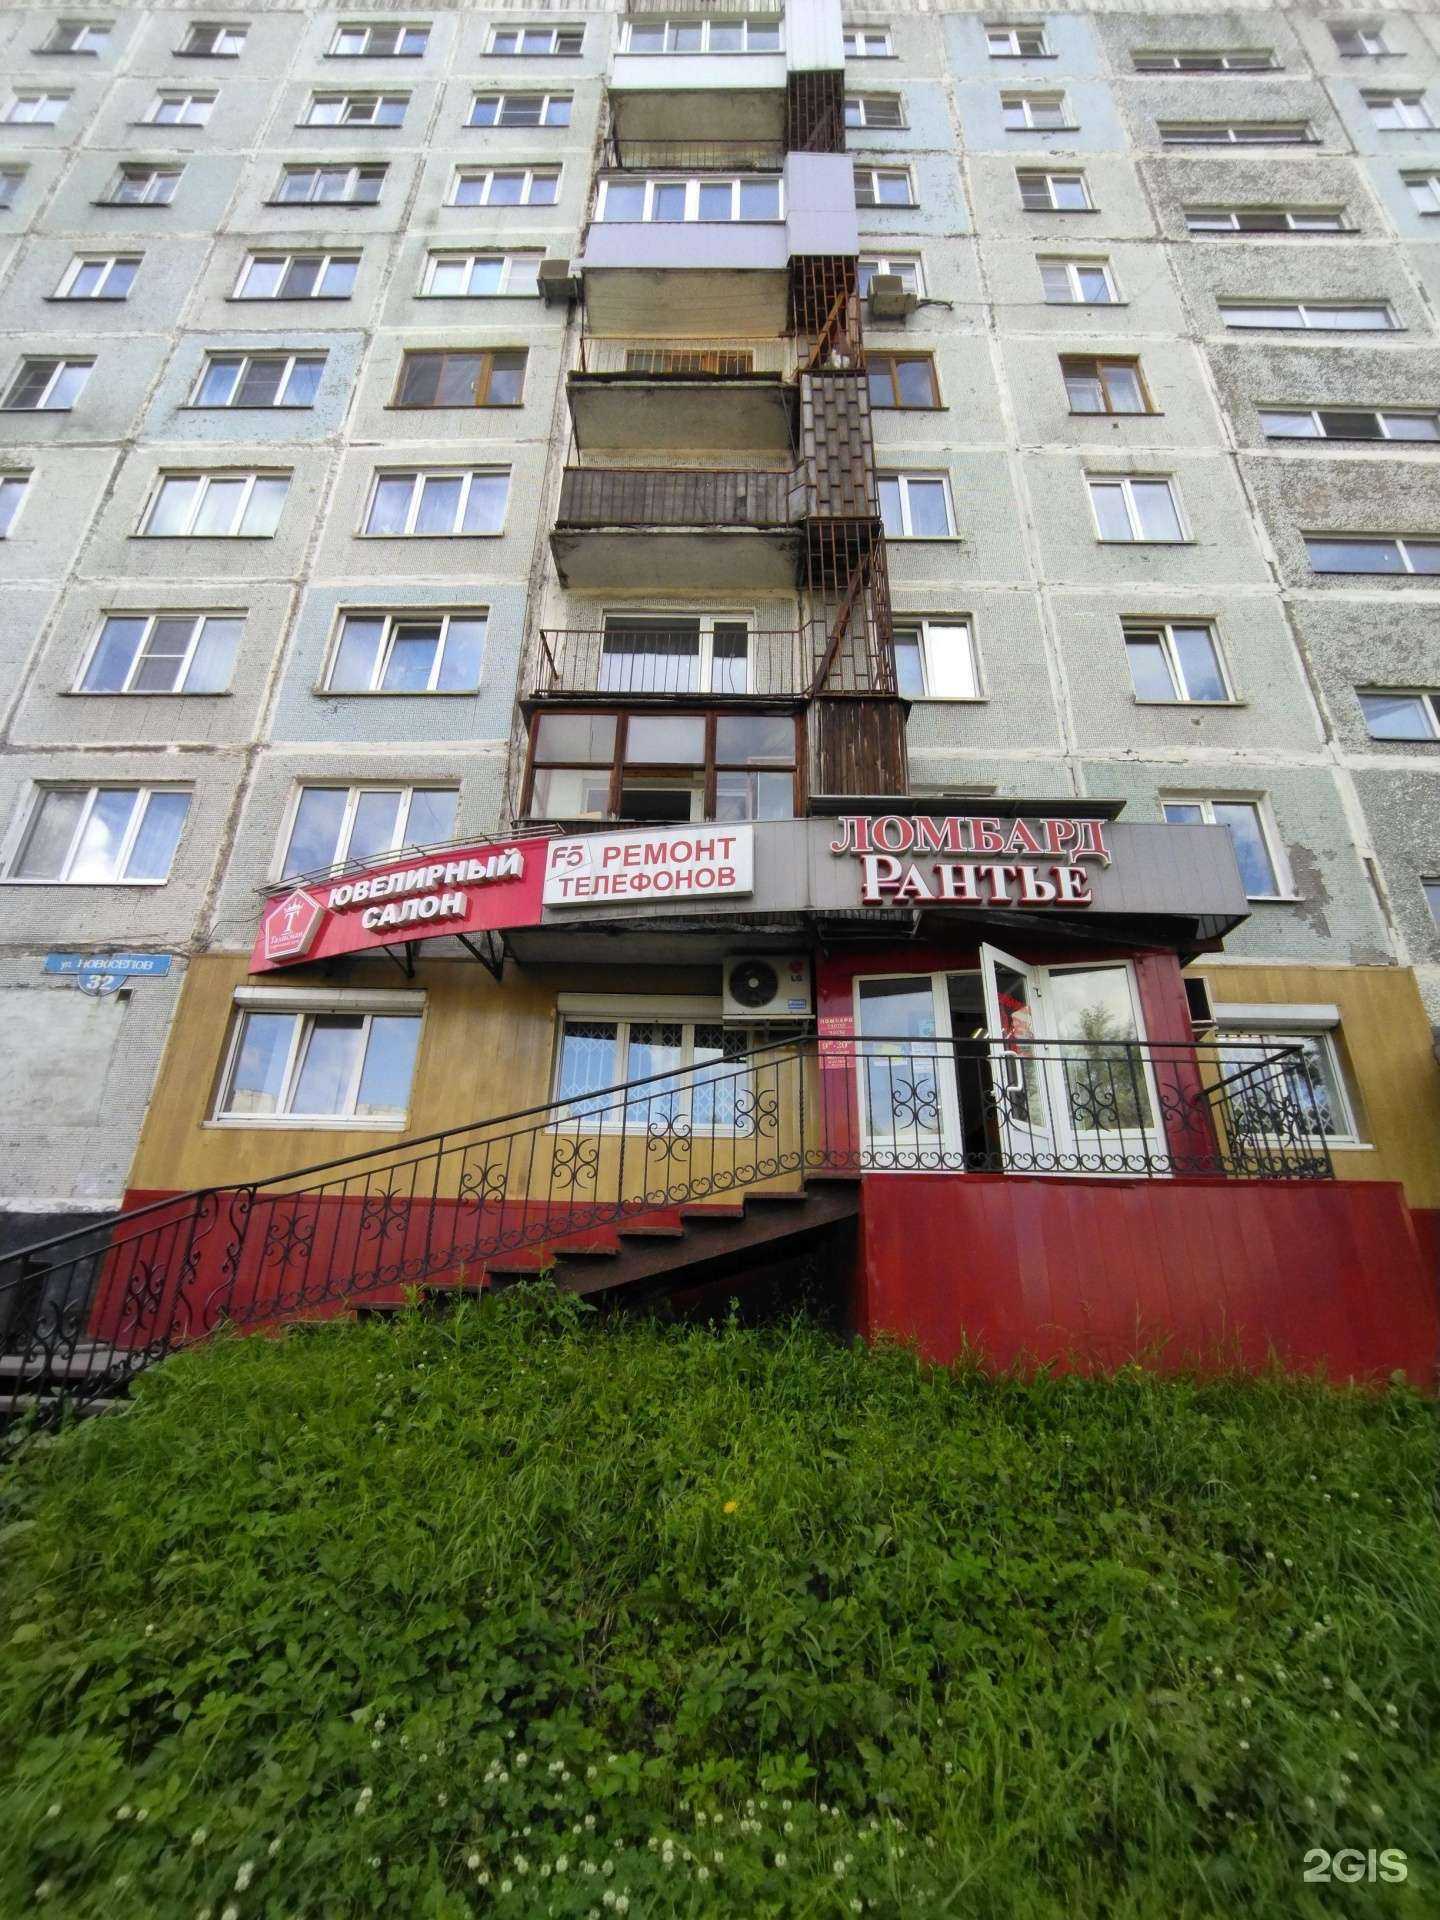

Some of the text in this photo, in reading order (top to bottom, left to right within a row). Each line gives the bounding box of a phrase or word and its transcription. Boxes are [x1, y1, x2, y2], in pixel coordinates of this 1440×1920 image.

[552, 845, 583, 868] F5
[602, 837, 737, 868] РЕМОНТ
[830, 815, 1113, 867] ЛОМБАРД
[328, 849, 526, 910] ЮВЕЛИРНЫЙ
[559, 868, 736, 897] ТЕЛЕФОНОВ
[362, 892, 469, 930] САЛОН
